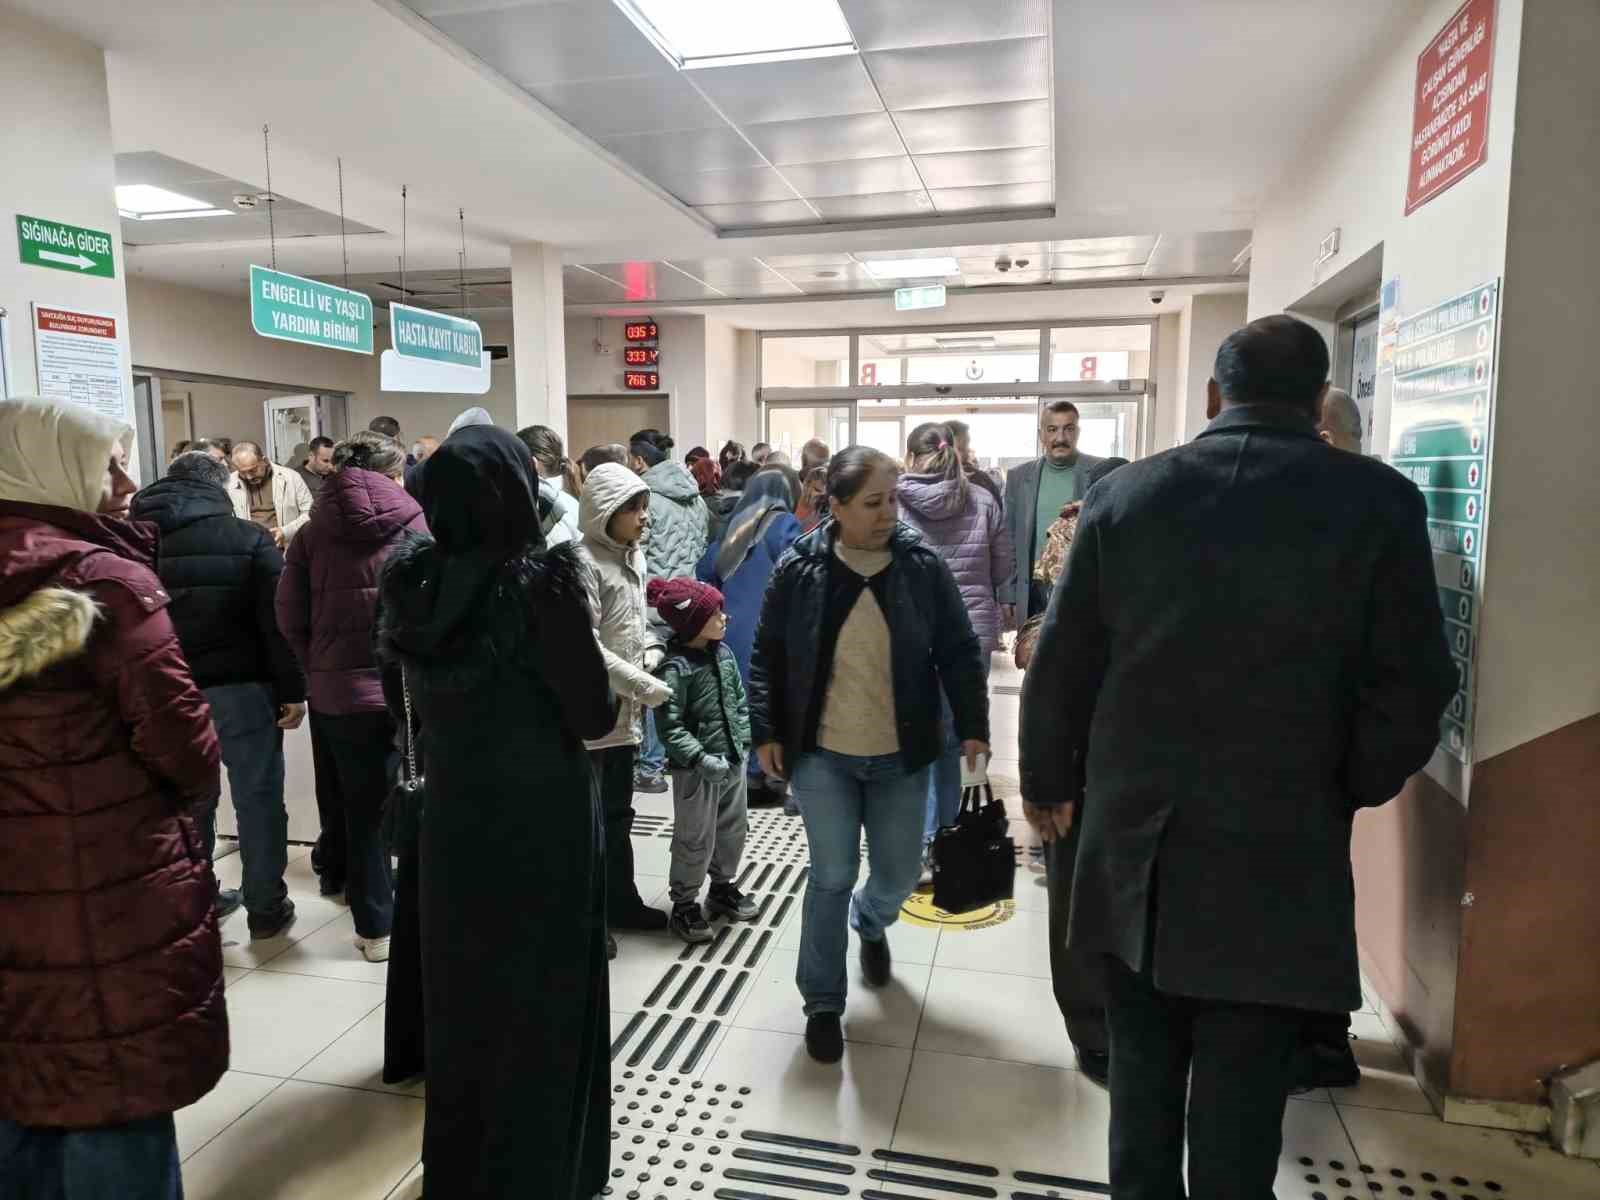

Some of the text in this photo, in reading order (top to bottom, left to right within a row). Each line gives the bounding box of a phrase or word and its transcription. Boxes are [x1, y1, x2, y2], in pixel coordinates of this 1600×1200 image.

[1422, 62, 1447, 105] ÇALIŞAN
[1431, 63, 1468, 112] AÇISINDAN
[1468, 71, 1488, 104] SAAT
[1421, 110, 1472, 166] GÖRÜNTÜ KAYDI
[21, 220, 111, 256] SIĞINAĞA GİDER
[262, 279, 366, 321] ENGELLİ VE YAŞLI
[271, 309, 360, 345] YARDIM BİRİMİ
[398, 319, 480, 358] HASTA KAYIT KABUL
[650, 375, 657, 385] 5
